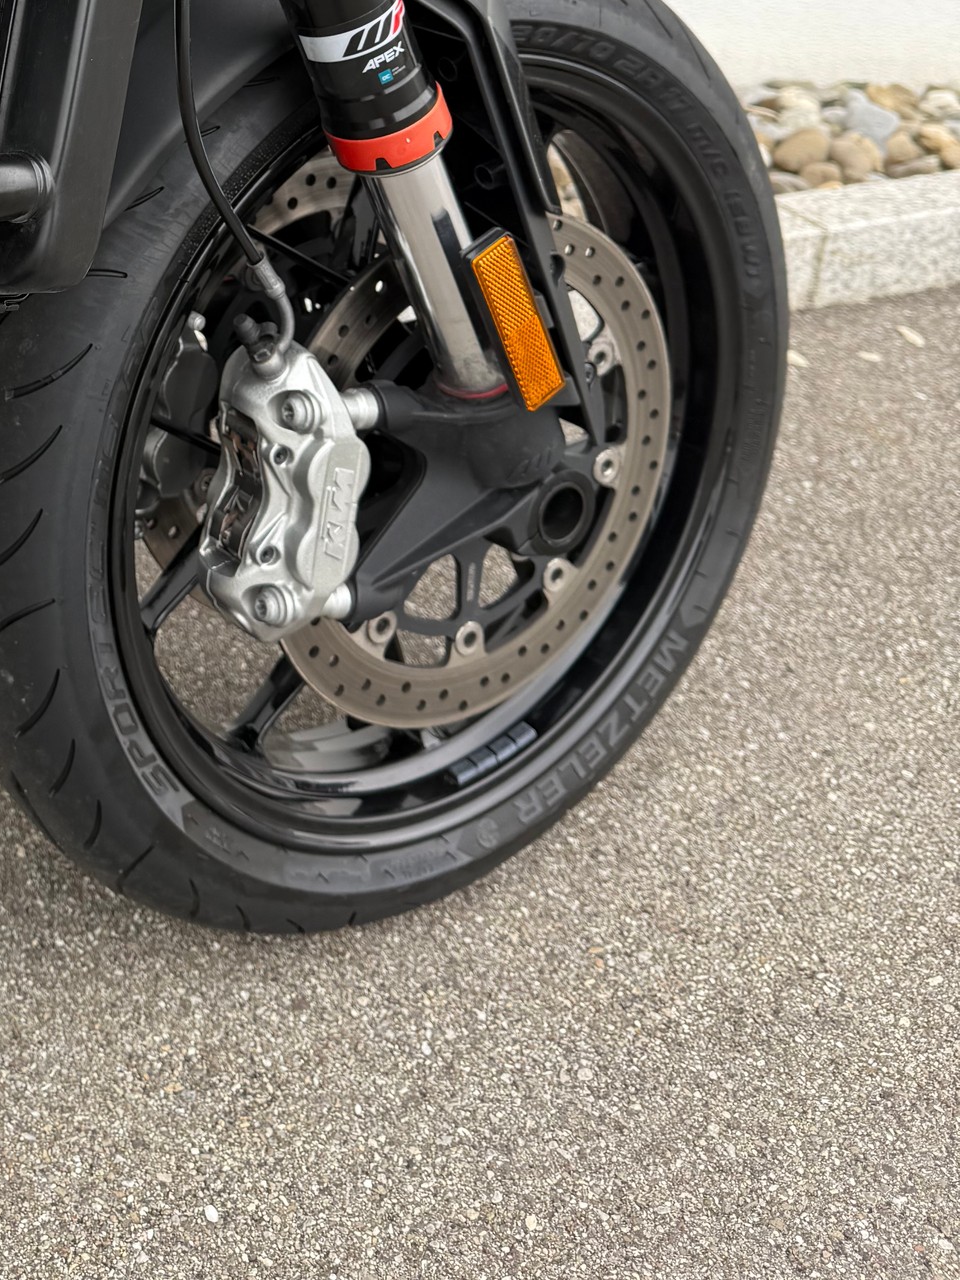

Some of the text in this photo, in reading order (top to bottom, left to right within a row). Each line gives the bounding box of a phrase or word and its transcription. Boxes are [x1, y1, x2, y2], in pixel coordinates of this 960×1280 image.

[362, 41, 405, 73] APEX
[88, 538, 183, 802] SPORTEC
[517, 629, 690, 827] METZELER
